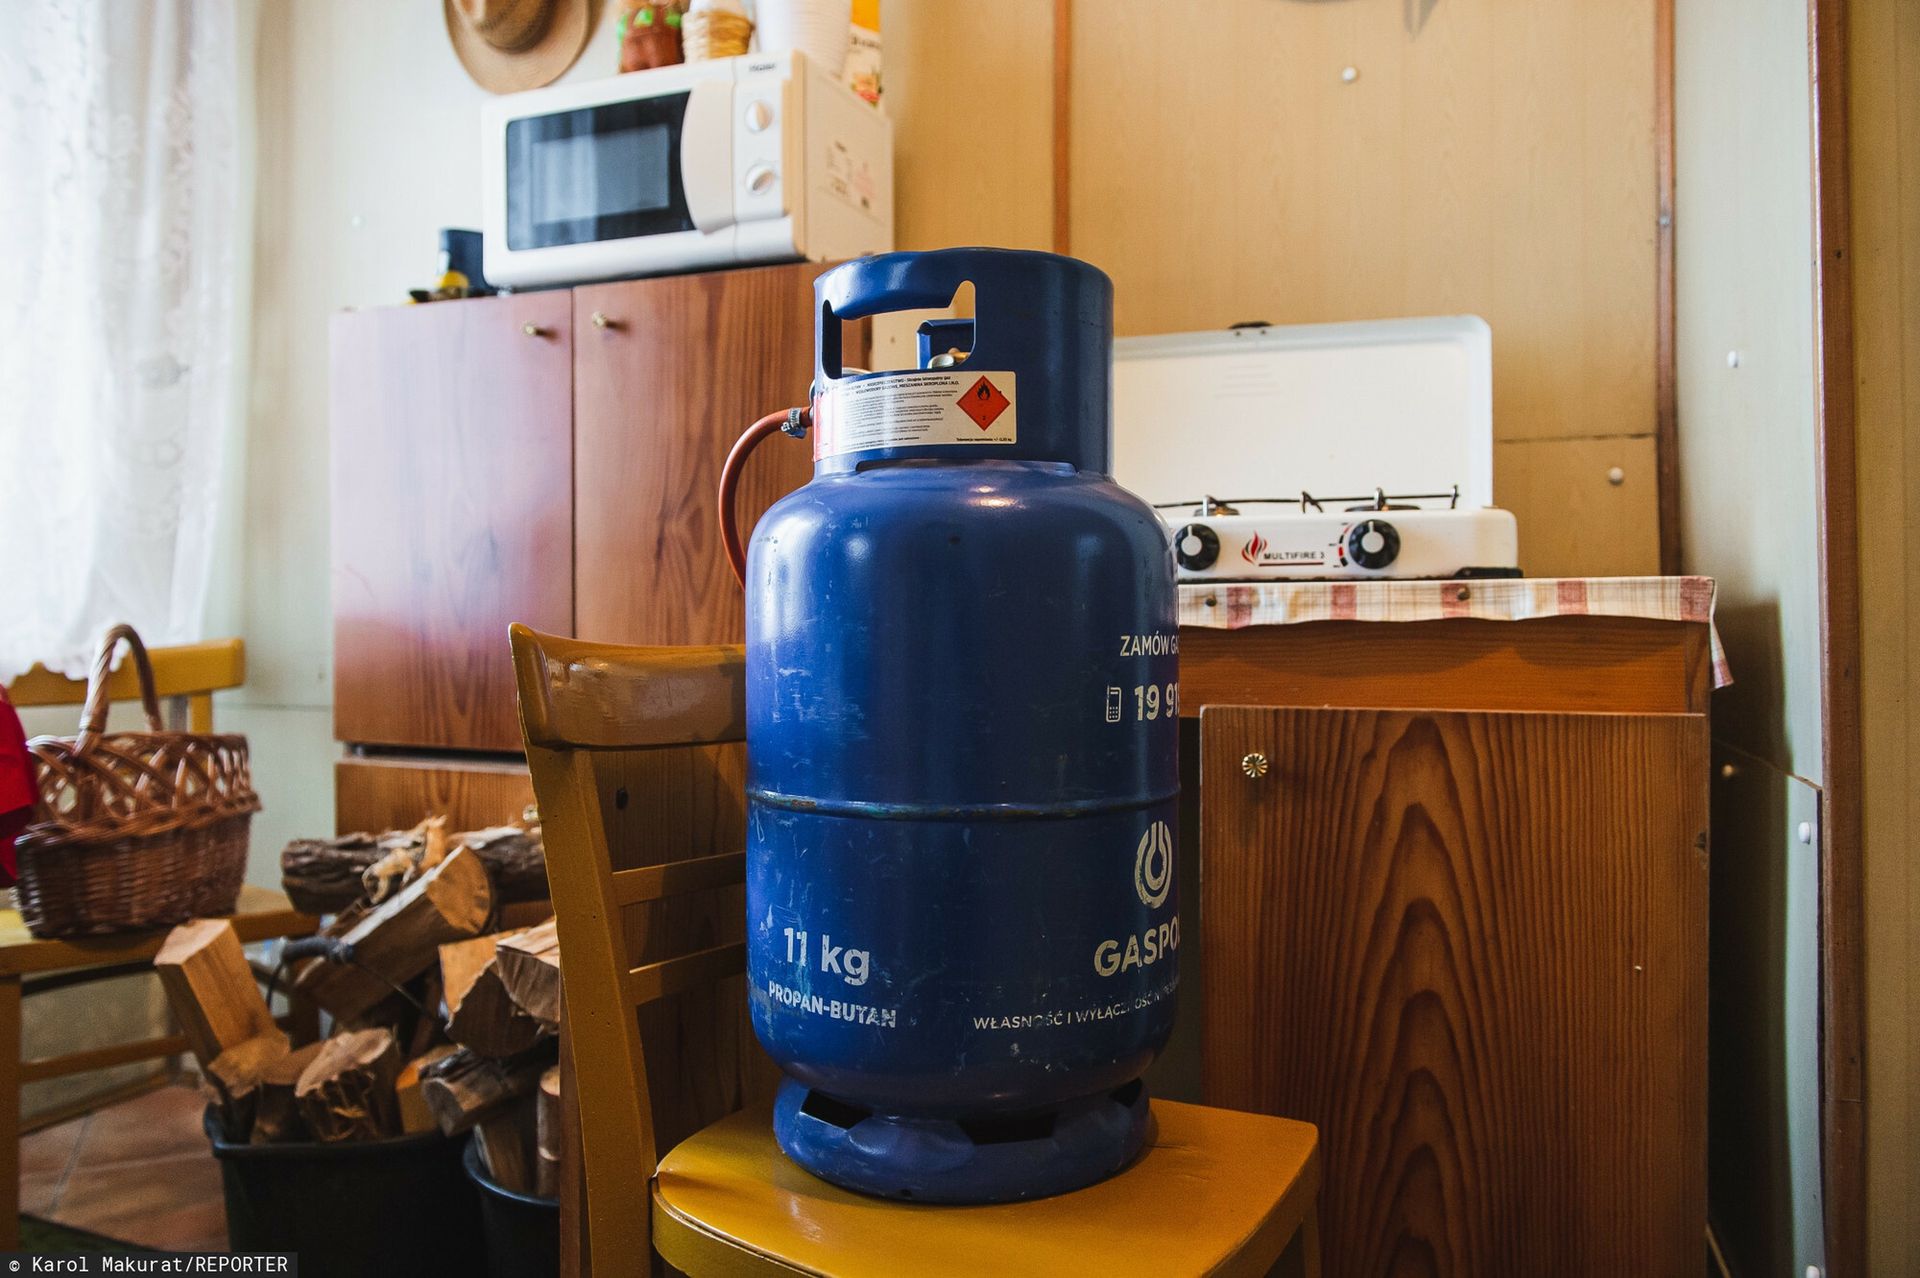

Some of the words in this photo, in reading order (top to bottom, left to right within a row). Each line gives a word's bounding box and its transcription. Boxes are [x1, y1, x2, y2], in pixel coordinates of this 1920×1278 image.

[1264, 551, 1316, 560] MULTIFIRE
[1120, 630, 1169, 657] ZAMÓW
[1134, 684, 1160, 721] 19
[784, 927, 808, 967] 11
[821, 934, 870, 986] kg
[768, 980, 897, 1028] PROPAN-BUTAN
[1067, 1012, 1071, 1024] I
